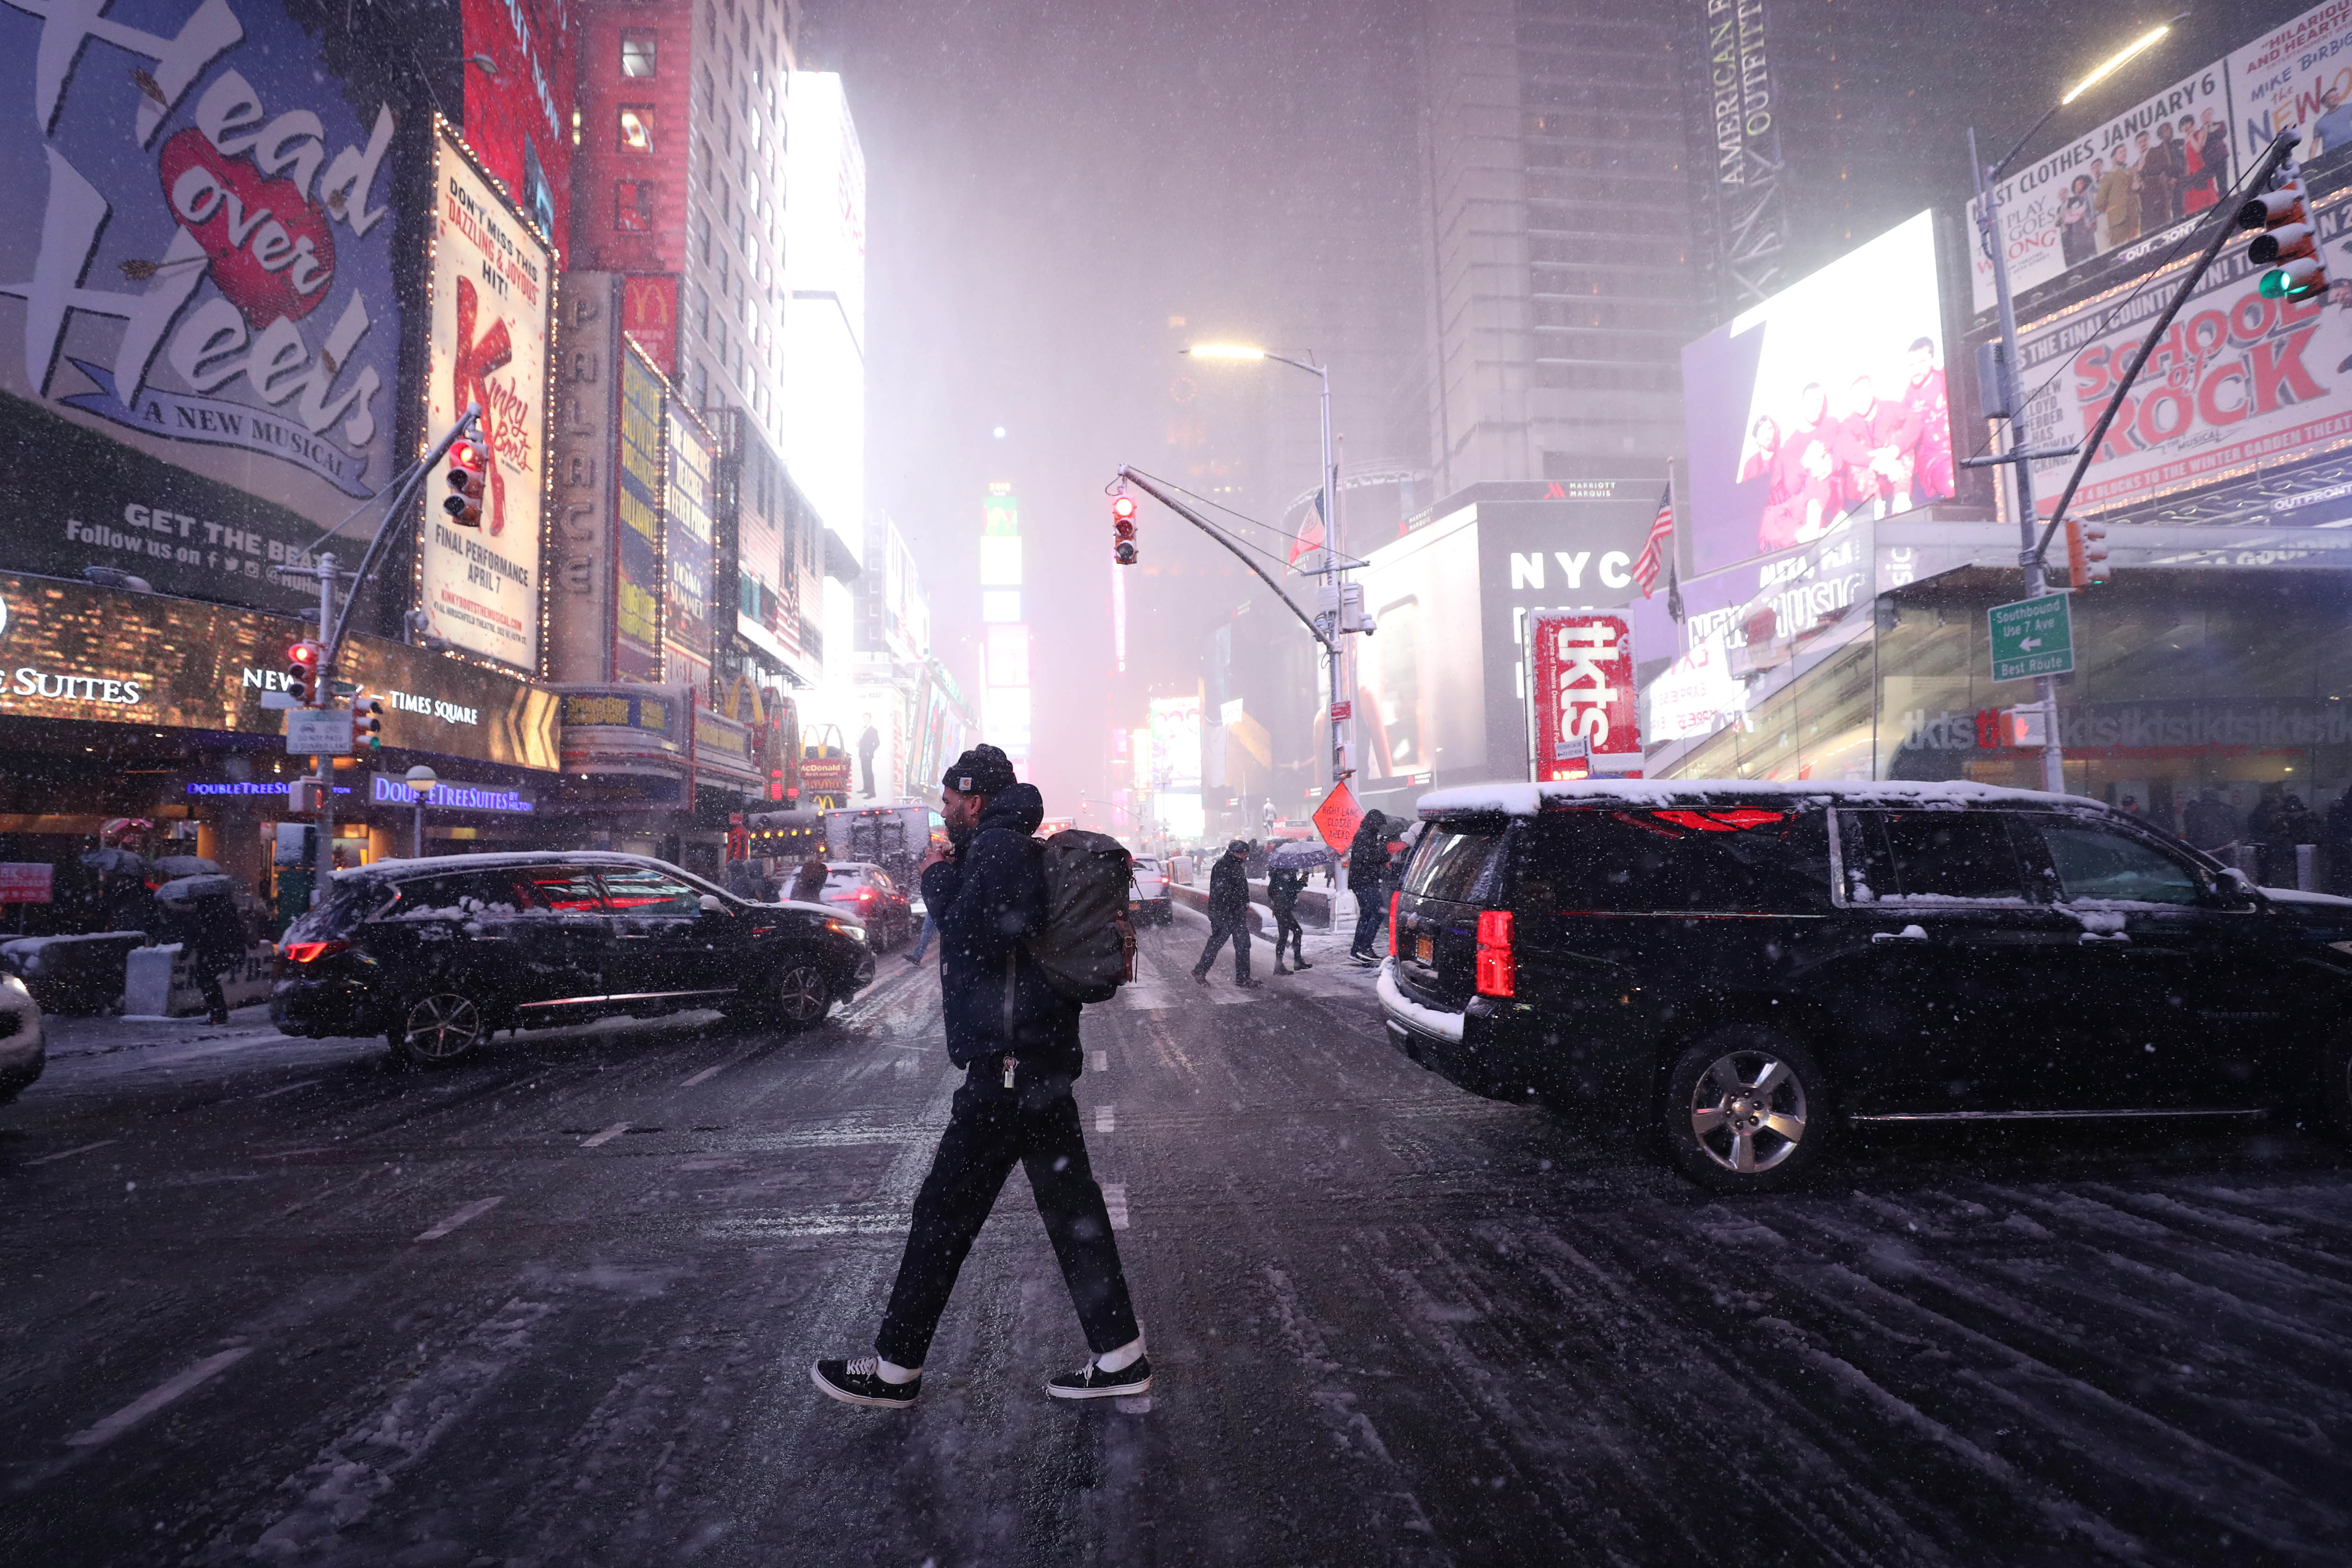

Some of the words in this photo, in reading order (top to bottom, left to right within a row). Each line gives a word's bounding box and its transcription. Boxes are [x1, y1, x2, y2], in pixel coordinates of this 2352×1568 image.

[2247, 49, 2281, 75] AND
[1710, 19, 1744, 184] AMERICAN
[2251, 66, 2292, 102] MIKE
[2020, 139, 2094, 194] CLOTHES
[2101, 81, 2196, 152] JANUARY
[2201, 72, 2216, 96] 6
[2247, 75, 2322, 156] NEW
[450, 176, 485, 225] DON'T
[487, 217, 513, 256] MISS
[516, 247, 538, 282] THIS
[2007, 195, 2046, 228] PLAY
[2009, 207, 2056, 241] GOES
[496, 249, 504, 273] &
[1977, 227, 2058, 274] WONG
[482, 259, 508, 301] HIT!
[2029, 336, 2059, 364] THE
[2059, 319, 2108, 350] FINAL
[2073, 283, 2322, 401] SCHOOL
[2167, 346, 2214, 394] of
[2080, 324, 2331, 465] ROCK
[144, 400, 165, 425] A
[175, 405, 242, 436] NEW
[251, 419, 344, 478] MUSICAL
[2030, 408, 2064, 431] EBBER
[2145, 472, 2160, 486] TO
[2163, 462, 2187, 481] THE
[2190, 447, 2241, 476] WINTER
[2244, 428, 2302, 458] GARDEN
[2178, 429, 2222, 451] MUSICAL
[124, 503, 196, 538] GET
[202, 521, 262, 556] THE
[1409, 507, 1433, 524] MARRIOTT
[1409, 517, 1431, 531] MARQUIS
[66, 518, 143, 554] Follow
[147, 539, 172, 559] us
[176, 545, 201, 566] on
[435, 523, 463, 555] FINAL
[465, 538, 529, 587] PERFORMANCE
[467, 564, 494, 591] APRIL
[495, 576, 501, 594] 7
[1510, 551, 1632, 590] NYC
[1996, 598, 2060, 624] Southbound
[2003, 625, 2022, 637] Use
[2024, 620, 2031, 632] 7
[2035, 618, 2055, 631] Ave
[1558, 621, 1620, 747] tkts
[2001, 661, 2025, 676] Best
[2029, 656, 2063, 672] Route
[14, 667, 140, 705] SUITES
[389, 690, 431, 716] TIMES
[434, 700, 478, 726] SQUARE
[1323, 806, 1340, 815] RIGHT
[1341, 808, 1359, 818] LANE
[1328, 818, 1352, 828] CLOSED
[1329, 829, 1351, 839] AHEAD
